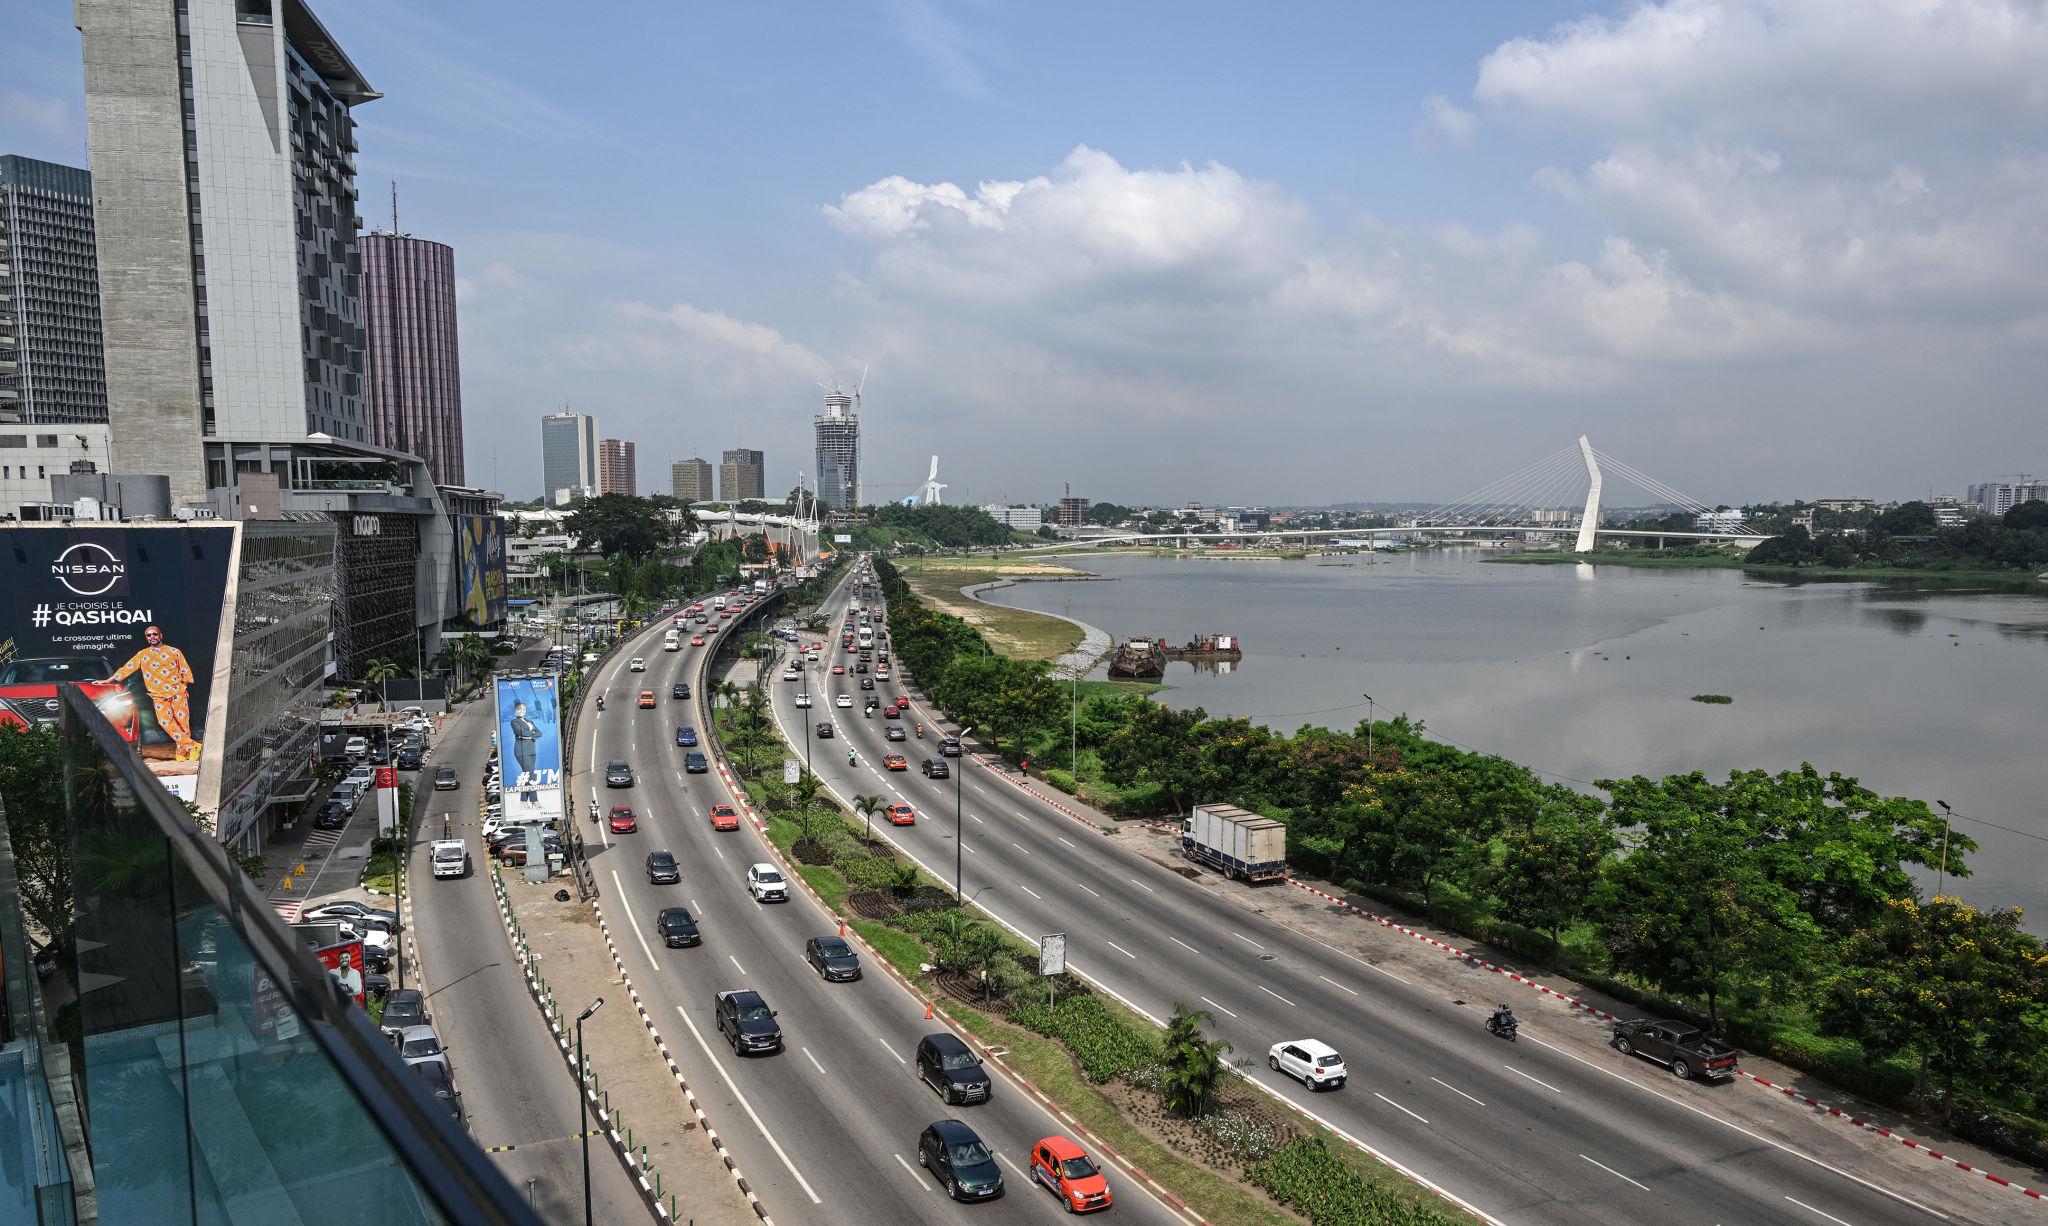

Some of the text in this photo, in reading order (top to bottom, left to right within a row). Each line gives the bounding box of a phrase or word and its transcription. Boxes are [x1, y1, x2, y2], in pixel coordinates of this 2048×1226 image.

[51, 565, 125, 574] NISSAN
[55, 601, 123, 611] JE CHOISIS LE
[106, 633, 132, 641] ultime
[72, 642, 116, 651] réimaginé.
